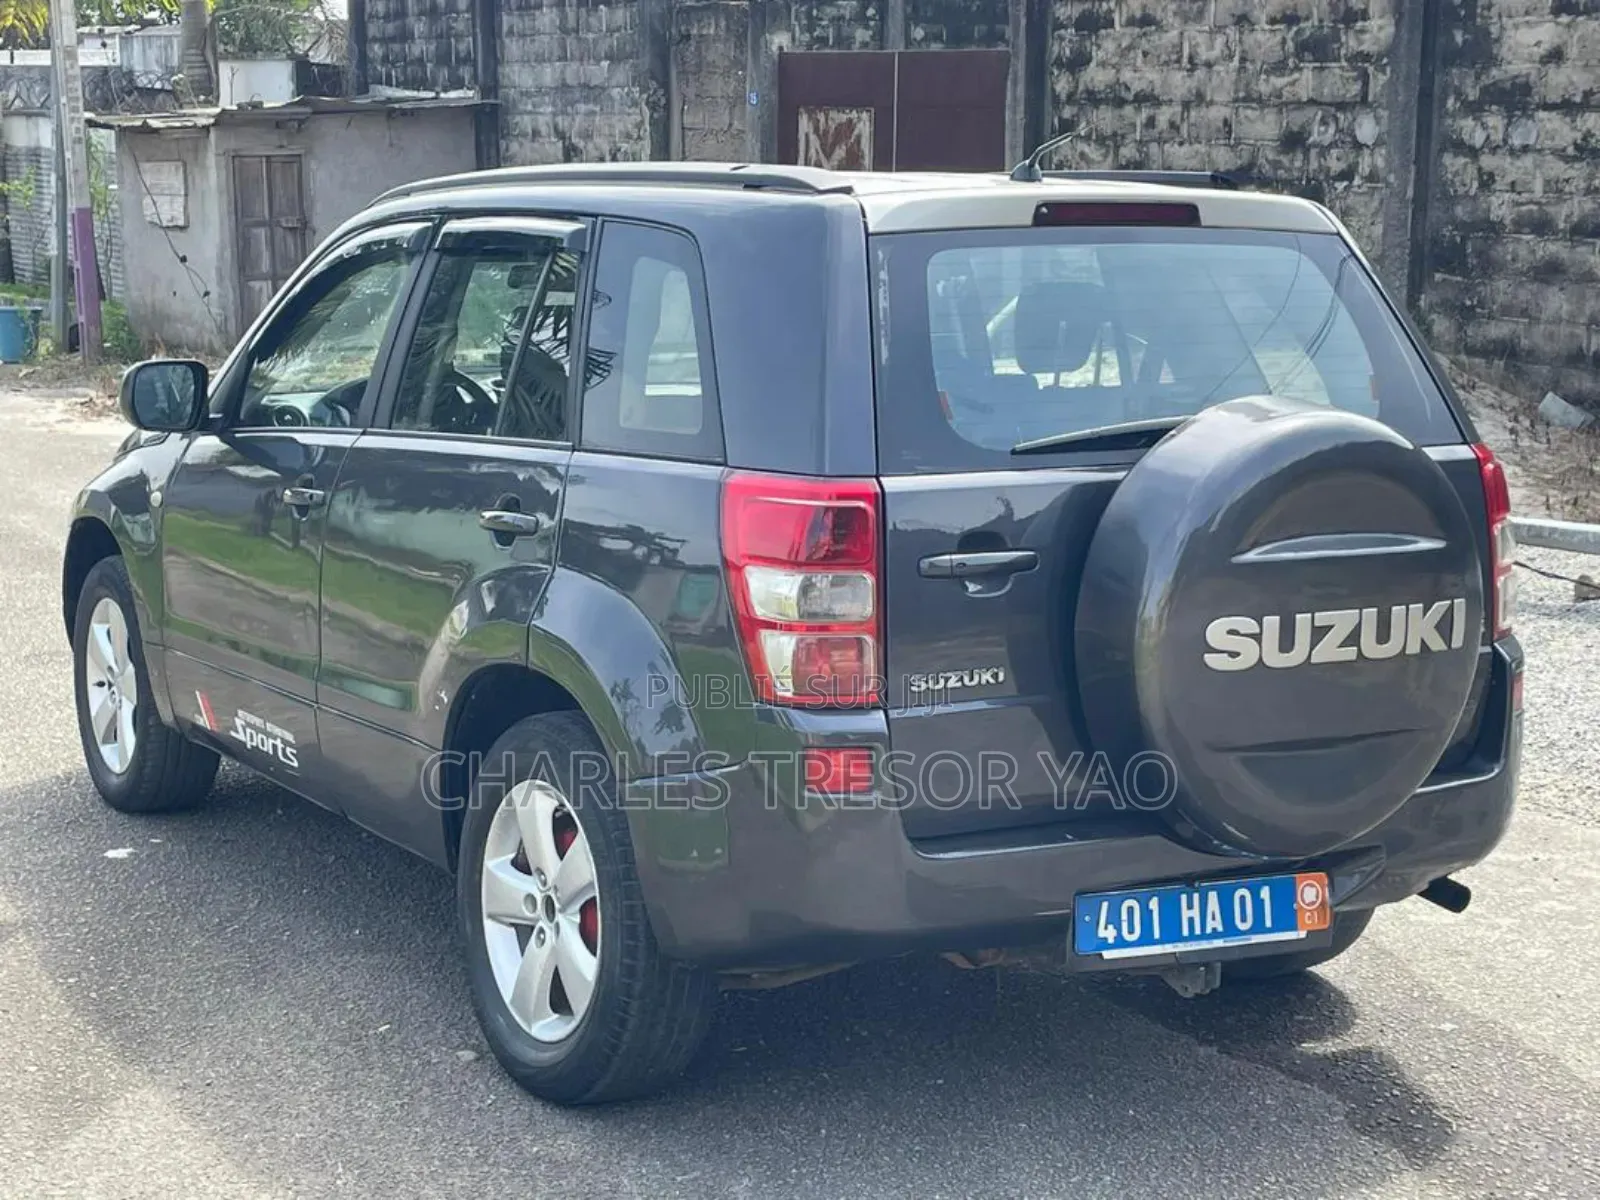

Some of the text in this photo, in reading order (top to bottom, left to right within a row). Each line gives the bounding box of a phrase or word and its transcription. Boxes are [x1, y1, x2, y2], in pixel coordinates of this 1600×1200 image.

[1203, 598, 1466, 672] SUZUKI
[909, 666, 1005, 692] SUZUKI
[229, 716, 299, 768] Sports
[1097, 895, 1161, 945] 401
